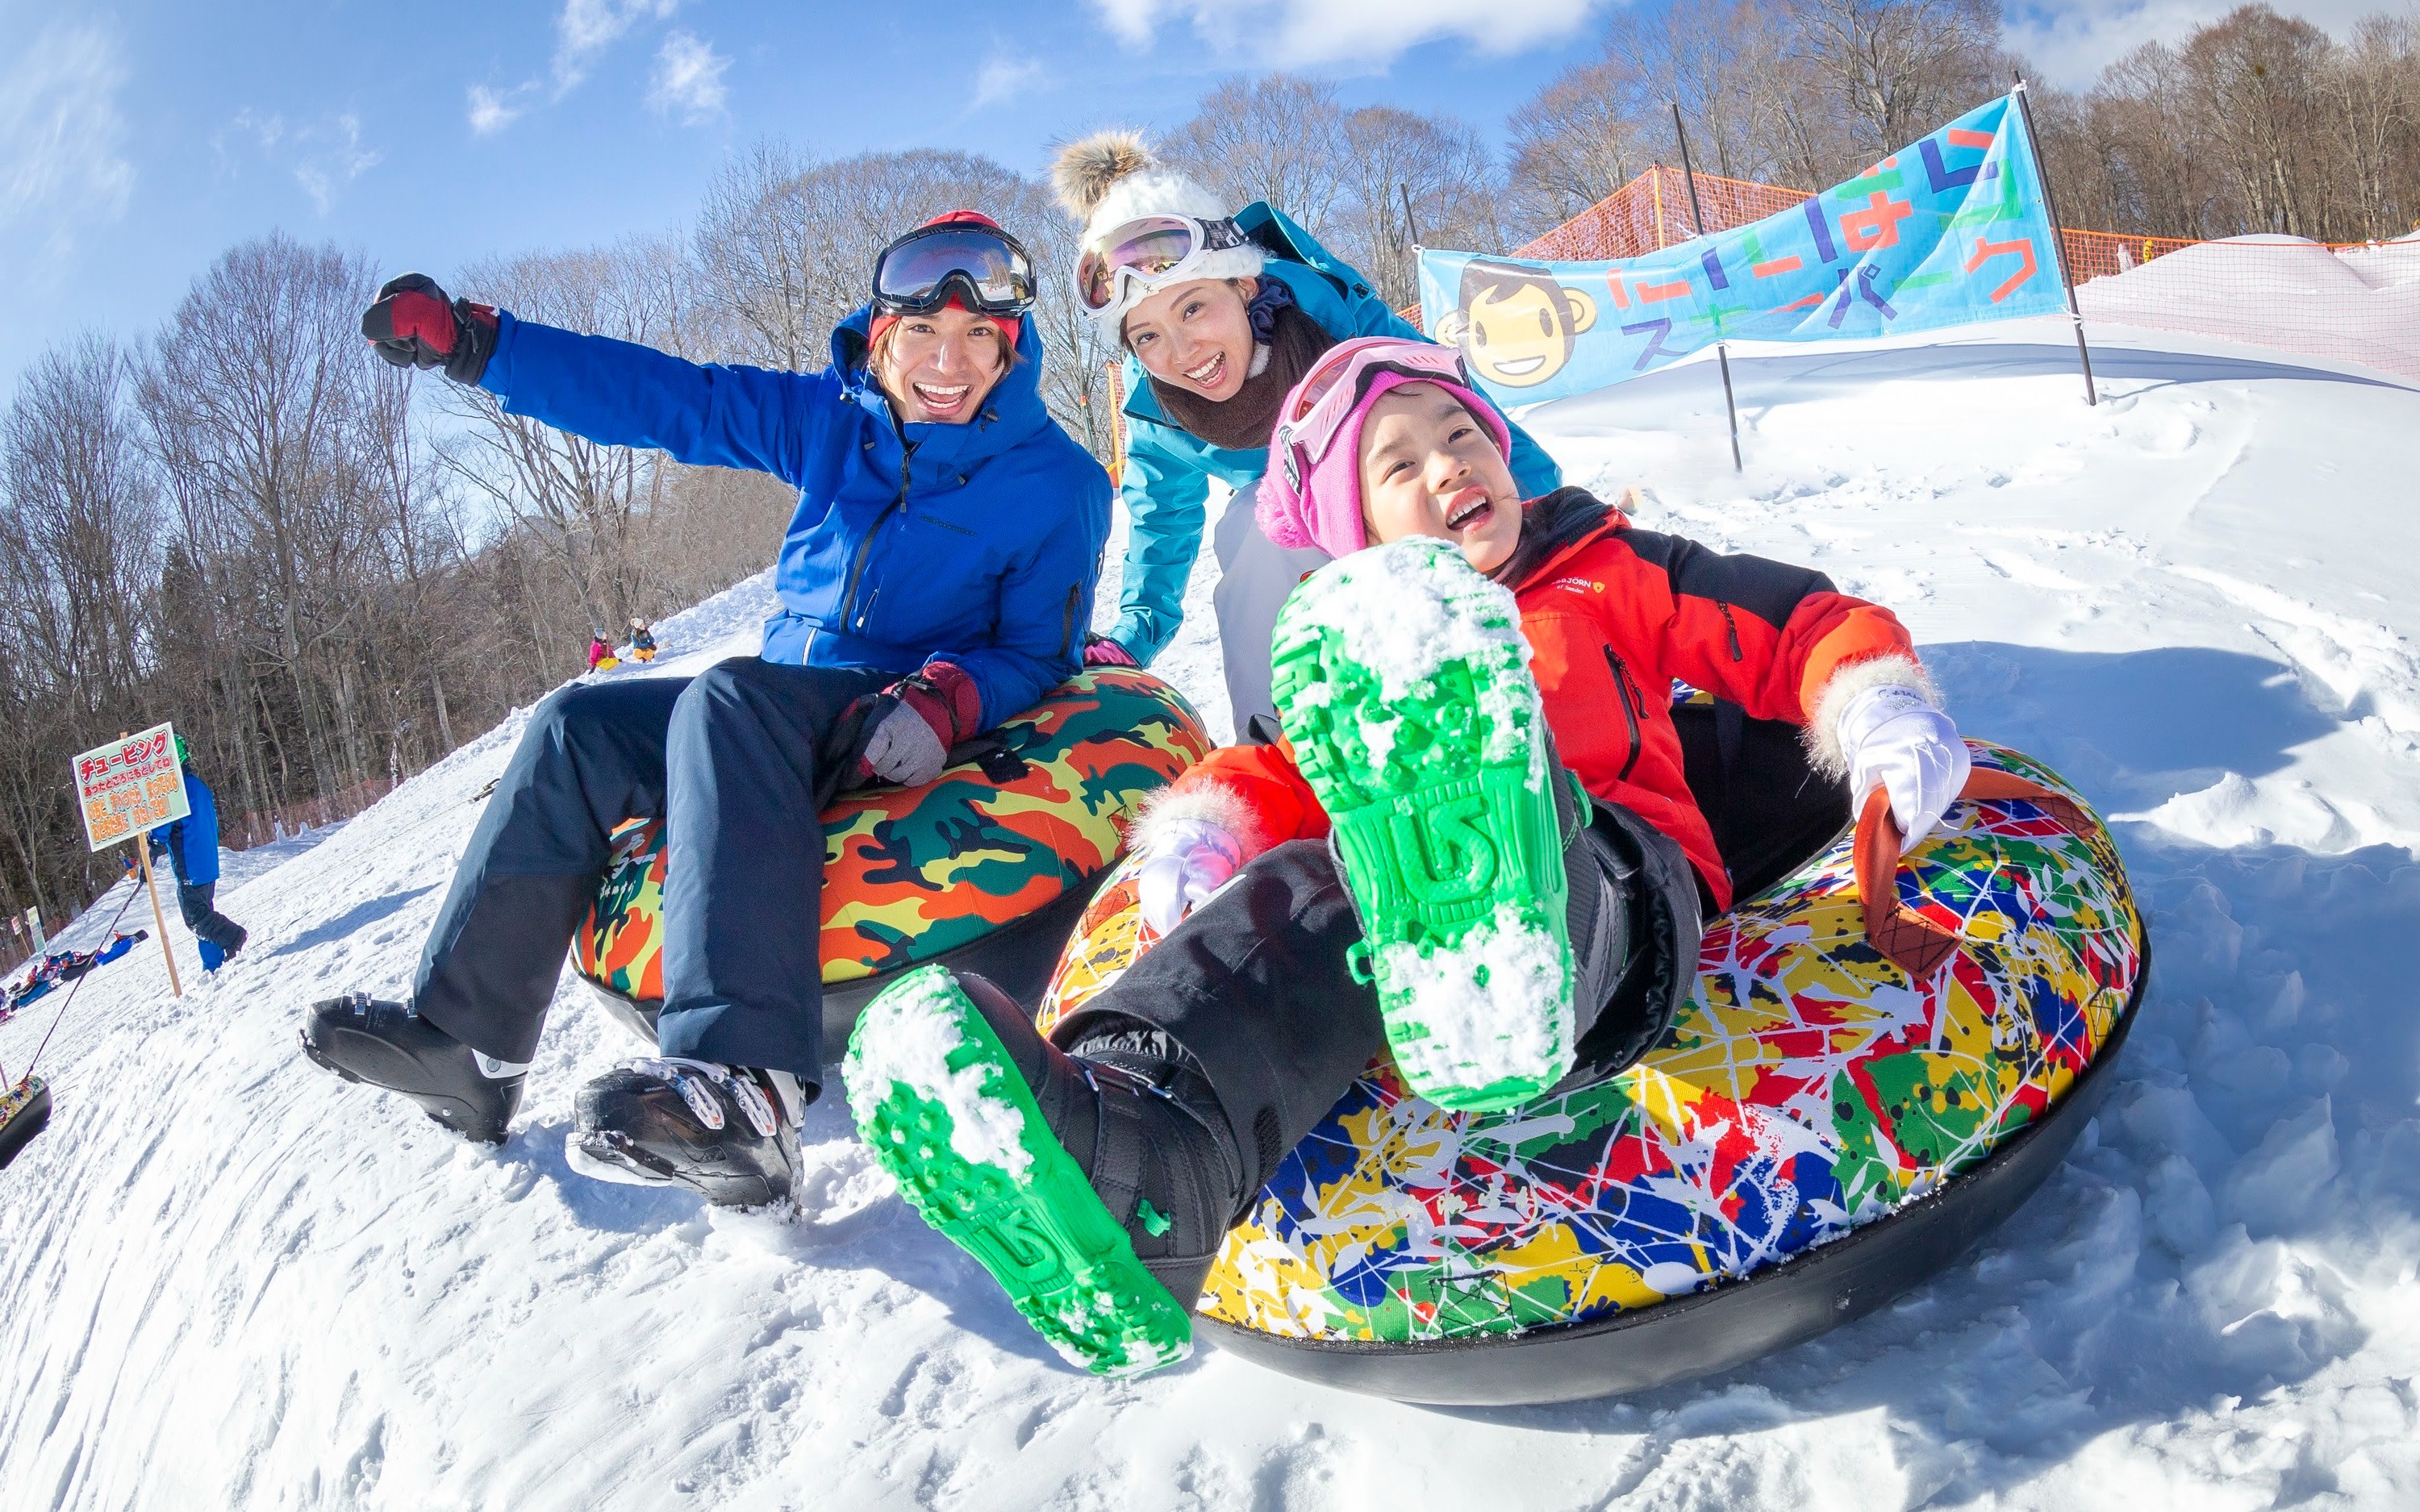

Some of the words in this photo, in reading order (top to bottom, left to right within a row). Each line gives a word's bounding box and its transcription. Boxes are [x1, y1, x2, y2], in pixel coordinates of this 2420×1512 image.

[1621, 237, 2037, 370] スキーパーク
[1565, 585, 1584, 594] Sweden
[80, 731, 168, 783] チュービング
